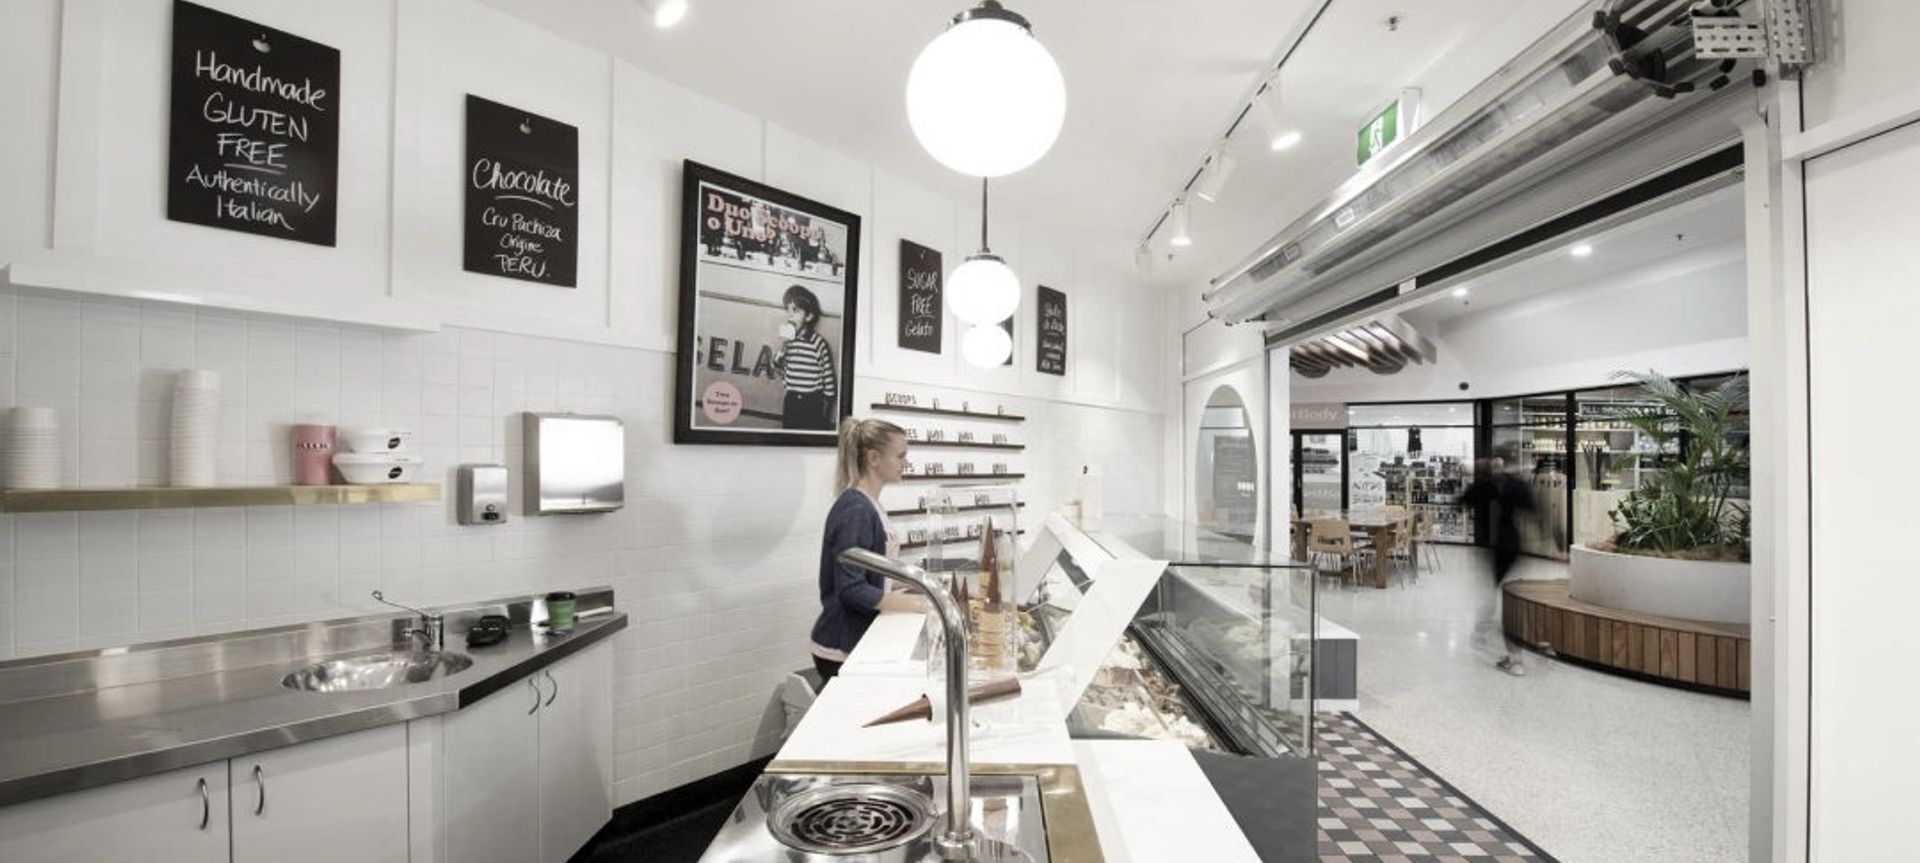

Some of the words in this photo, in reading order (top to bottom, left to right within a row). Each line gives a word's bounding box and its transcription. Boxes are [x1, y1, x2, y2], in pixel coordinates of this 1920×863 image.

[195, 50, 327, 112] Handmade
[203, 92, 308, 142] GLUTEN
[217, 132, 288, 168] FREE
[185, 164, 320, 213] Authentically
[472, 157, 575, 206] Chocolate
[216, 199, 295, 231] Italian
[707, 193, 750, 220] Duo
